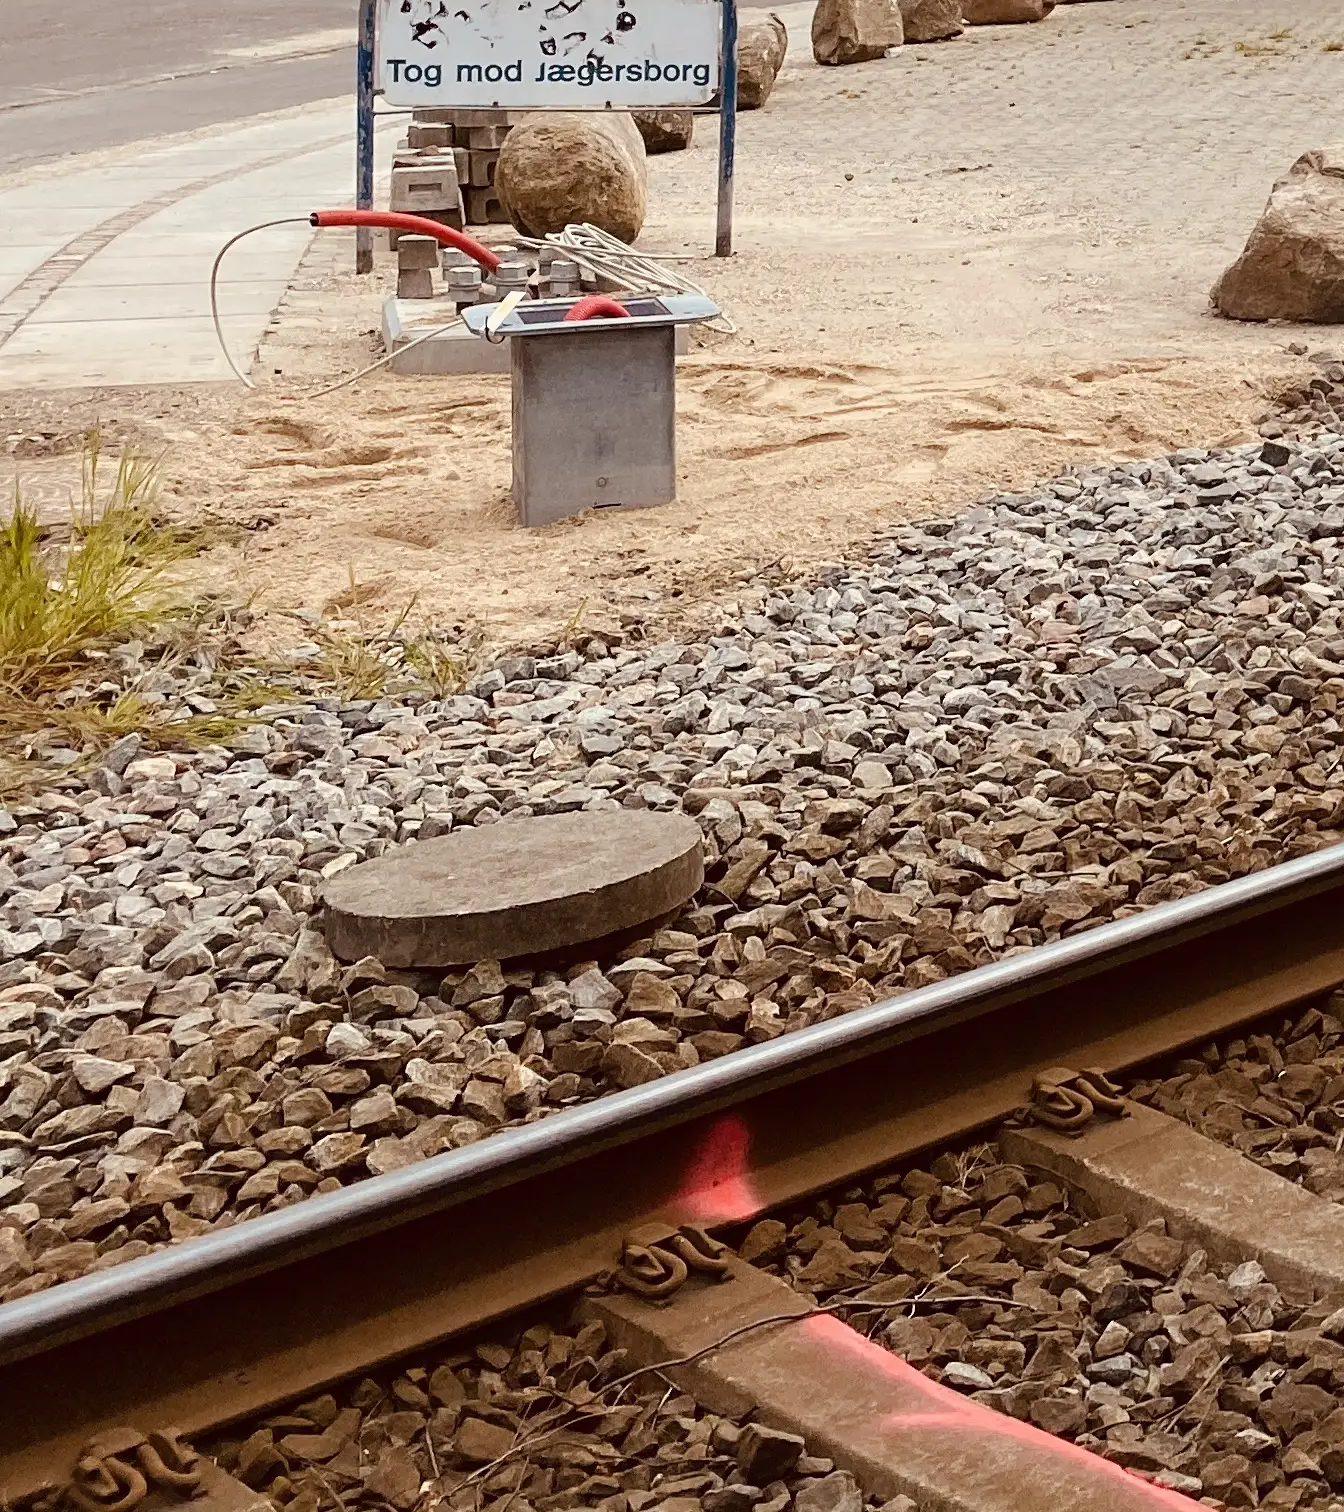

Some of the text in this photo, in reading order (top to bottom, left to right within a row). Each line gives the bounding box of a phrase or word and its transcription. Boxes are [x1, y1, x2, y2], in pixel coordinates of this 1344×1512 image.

[386, 59, 711, 87] Tog mod Jægersborg
